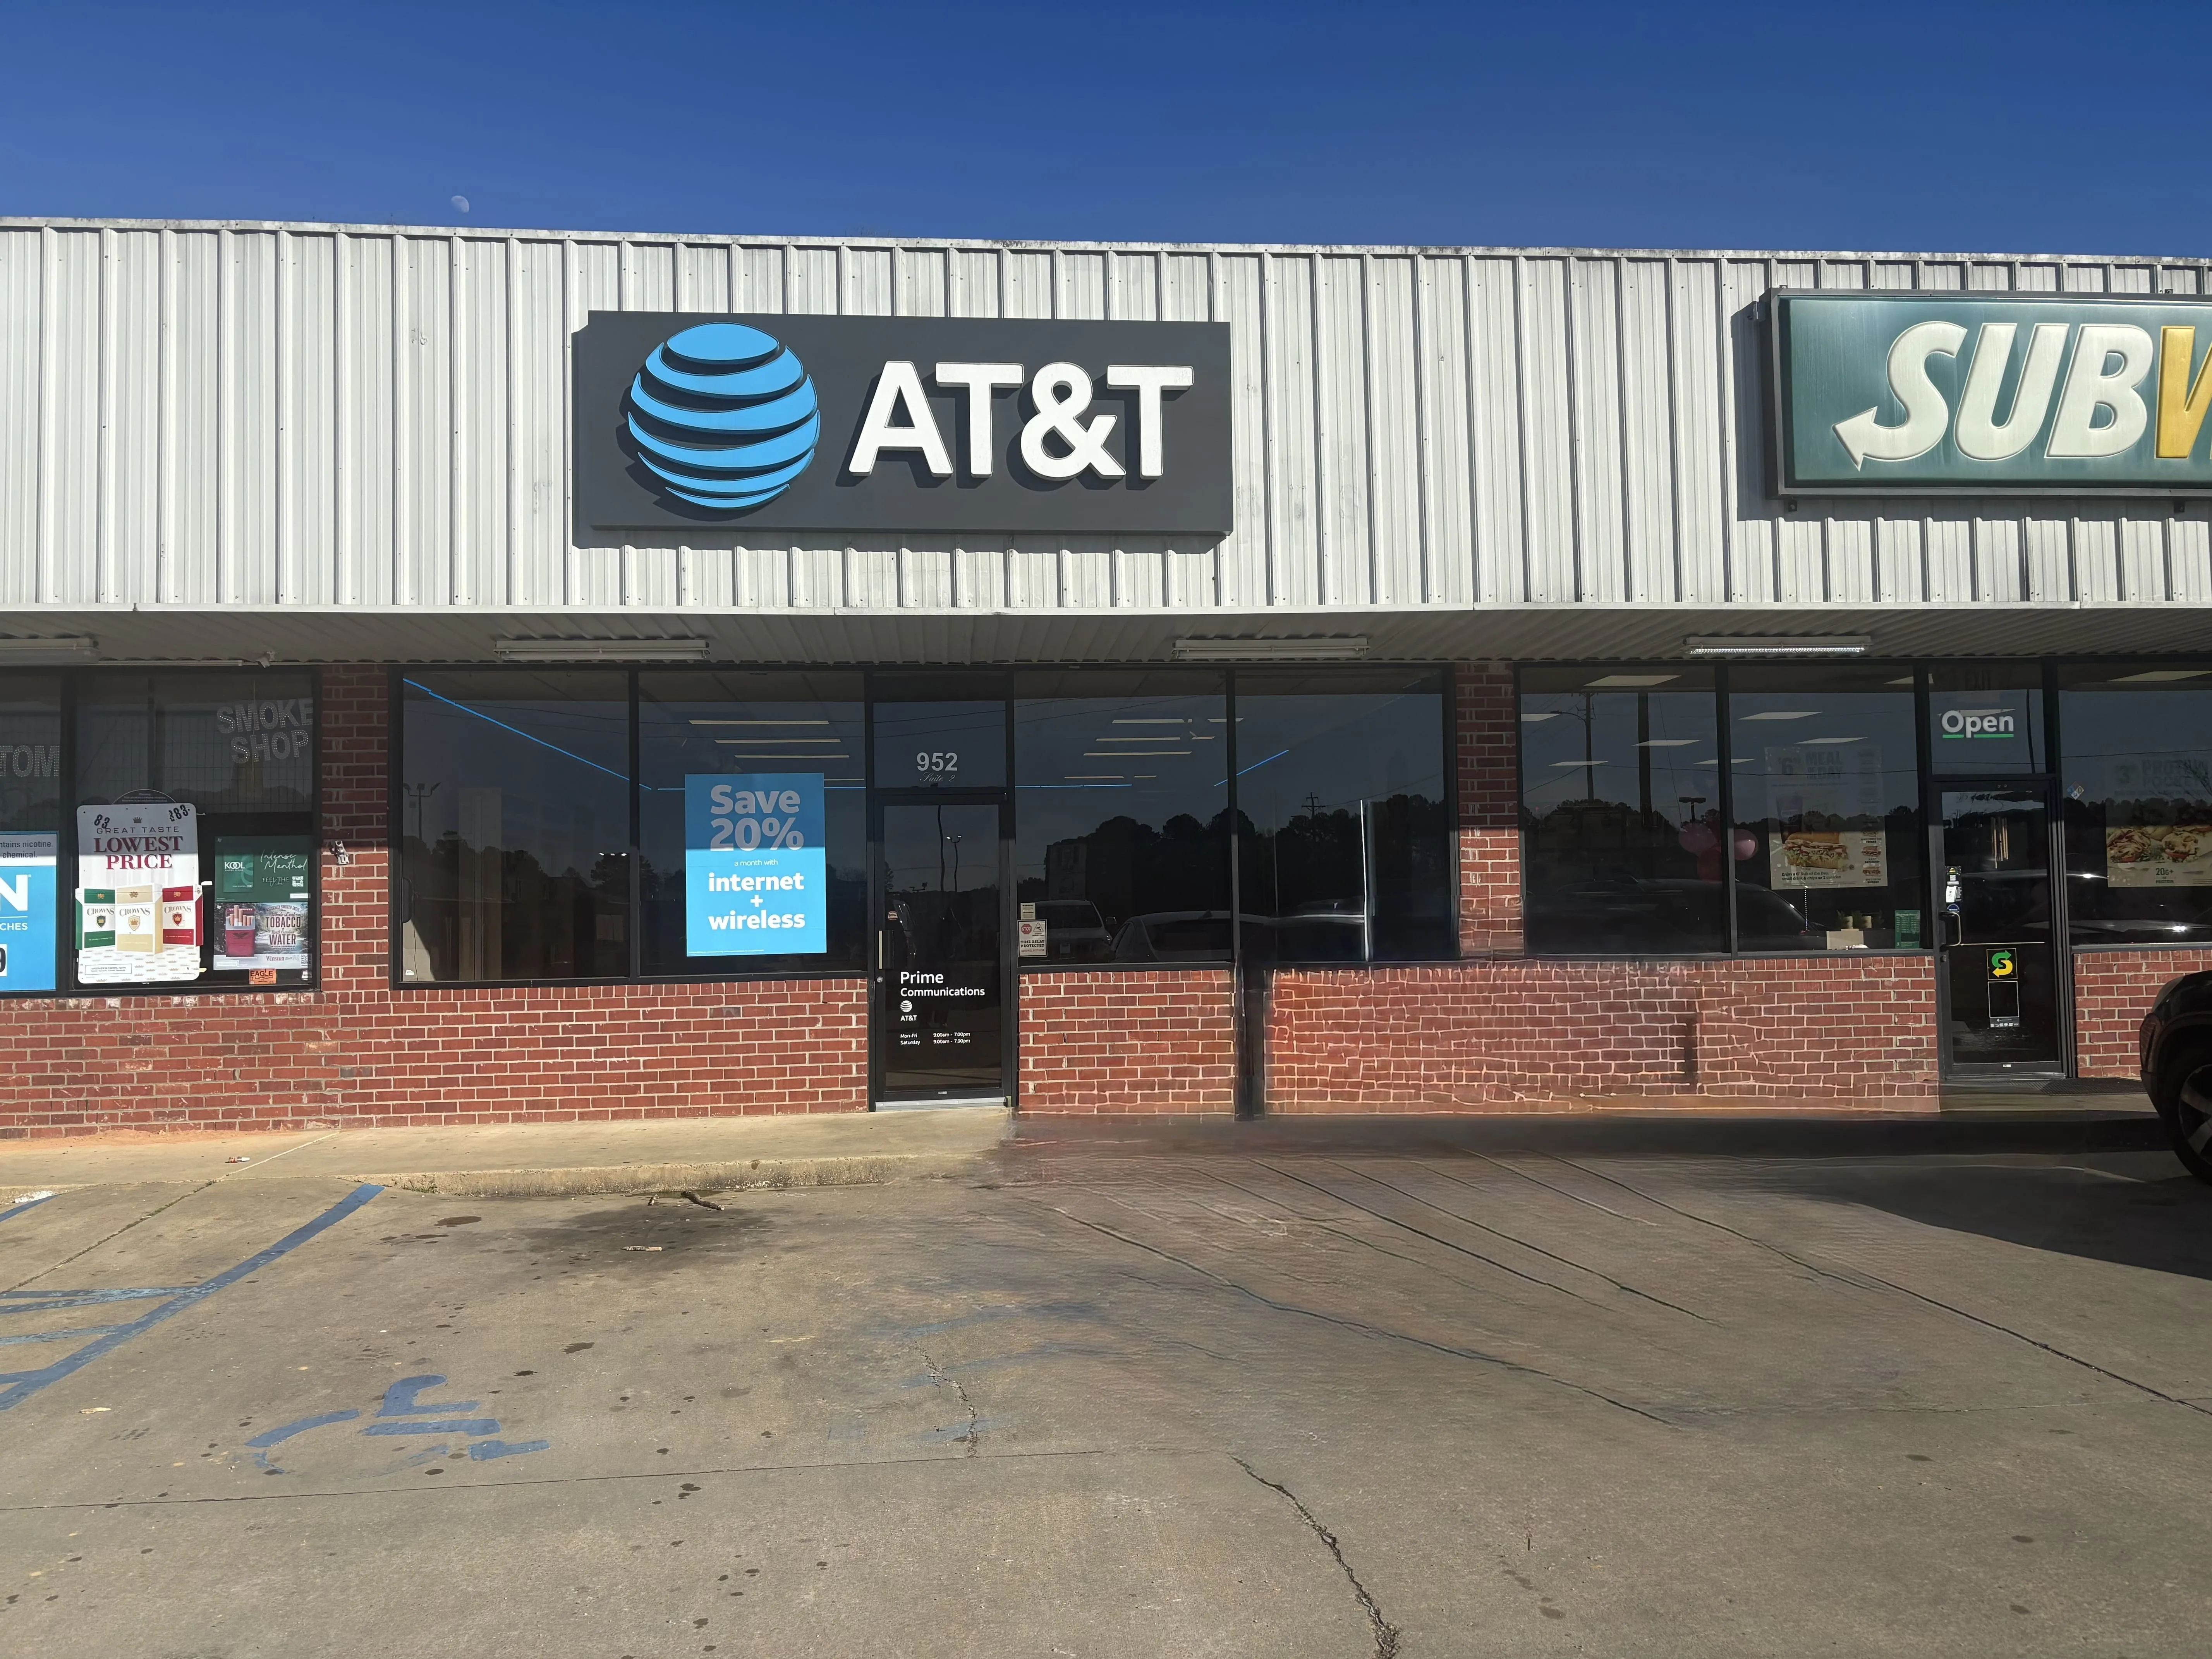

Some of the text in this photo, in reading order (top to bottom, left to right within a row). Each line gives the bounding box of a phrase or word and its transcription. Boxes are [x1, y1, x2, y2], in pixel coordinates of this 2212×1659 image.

[849, 361, 1194, 481] AT&T
[217, 697, 313, 733] SMOKE
[1942, 710, 2014, 738] Open
[231, 730, 309, 763] SHOP
[917, 752, 958, 771] 952
[920, 772, 944, 781] Suite
[710, 785, 800, 814] Save
[710, 817, 804, 851] 20%
[93, 836, 183, 852] LOWEST
[3, 850, 37, 859] chemical.
[105, 854, 173, 870] PRICE
[260, 849, 297, 862] Intense
[264, 858, 307, 873] Menthol
[709, 872, 804, 891] internet
[87, 908, 115, 916] CROWNS
[119, 908, 150, 917] CROWNS
[164, 905, 192, 914] CROWNS
[266, 917, 301, 928] TOBACCO
[708, 910, 805, 930] wireless
[269, 934, 296, 945] WATER
[900, 971, 944, 984] Prime
[900, 987, 985, 996] Communications
